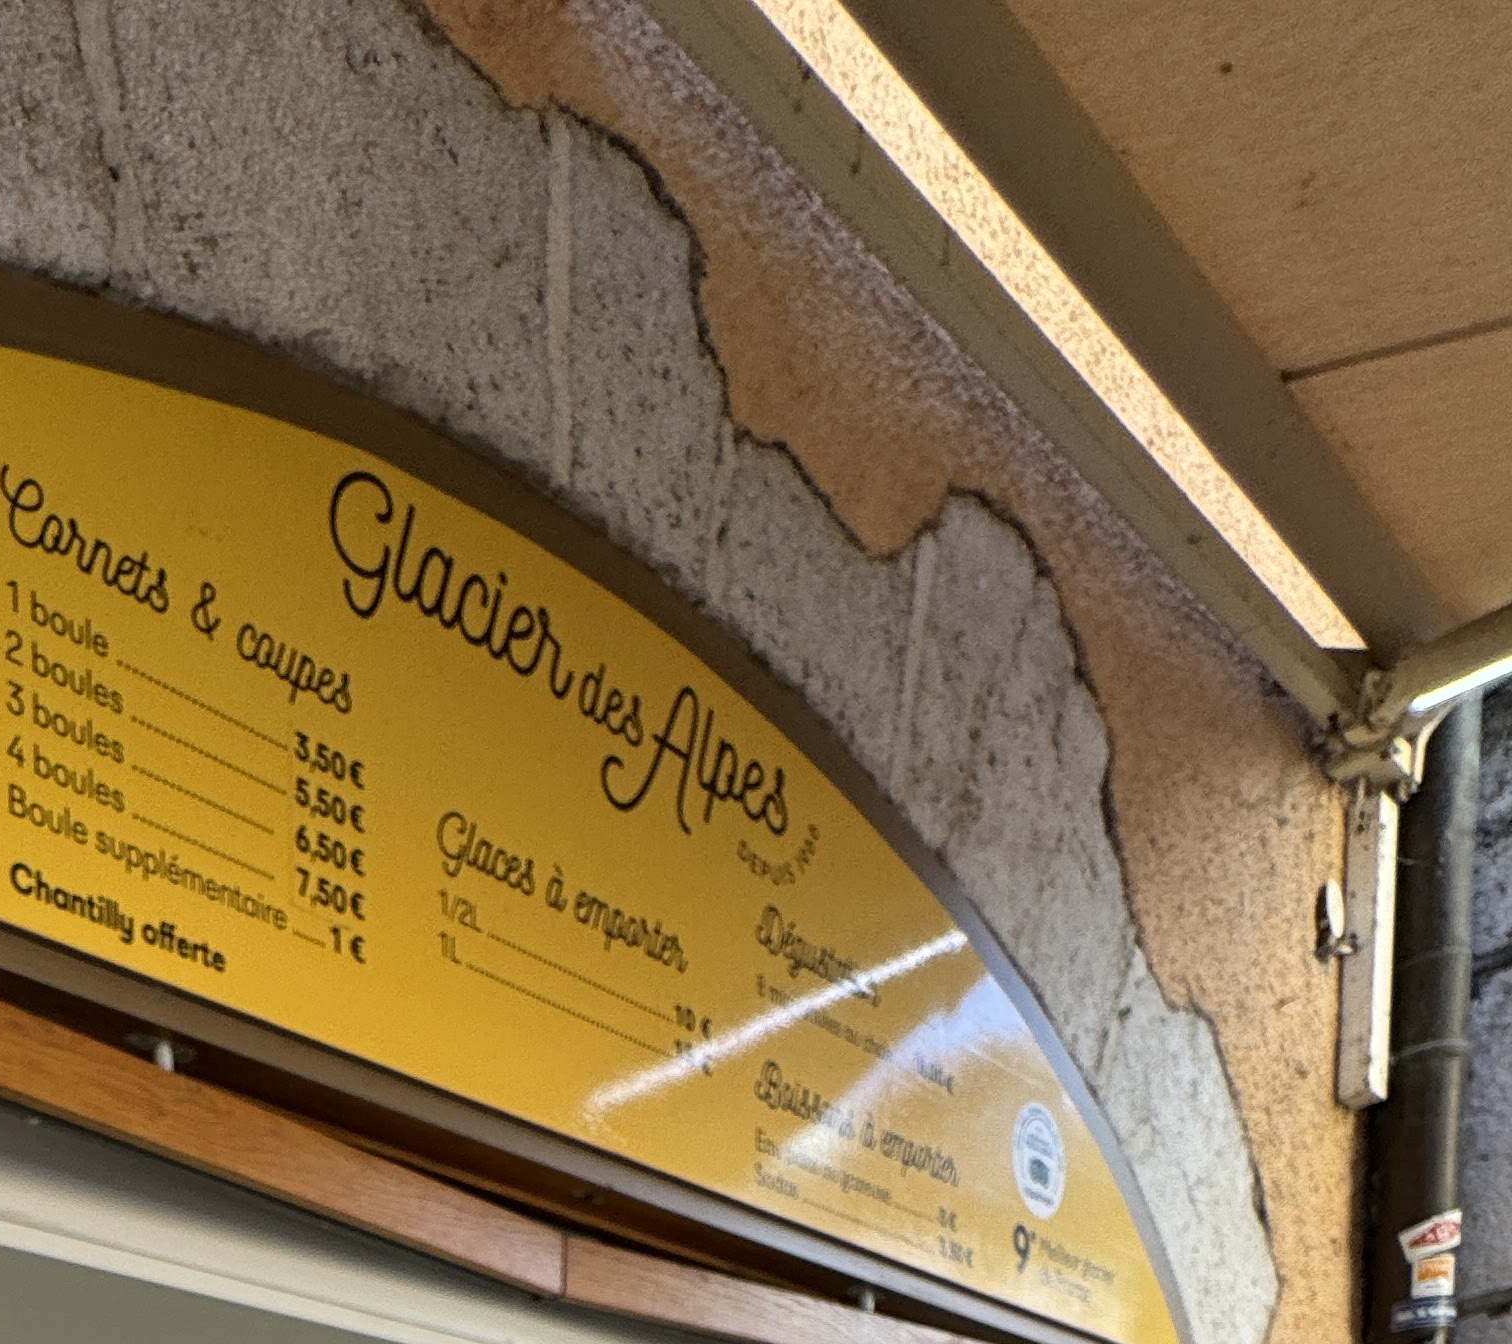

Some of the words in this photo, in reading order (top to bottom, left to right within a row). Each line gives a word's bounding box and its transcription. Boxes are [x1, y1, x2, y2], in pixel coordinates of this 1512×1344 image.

[0, 464, 169, 613] Cornets
[190, 580, 222, 641] &
[237, 623, 352, 714] coupes
[6, 580, 19, 612] 1
[30, 590, 109, 657] boule
[329, 471, 575, 699] Glacier
[4, 629, 24, 666] 2
[31, 640, 123, 714] boules
[5, 680, 25, 716] 3
[32, 692, 125, 764] boules
[578, 663, 644, 746] des
[6, 735, 25, 768] 4
[33, 743, 125, 813] boules
[600, 687, 787, 835] Alpes
[7, 783, 89, 845] Boule
[95, 830, 288, 931] supplémentaire
[437, 810, 535, 897] Glaces
[545, 862, 568, 912] à
[573, 889, 688, 974] emporter
[9, 862, 135, 944] Chantilly
[141, 920, 226, 972] offerte
